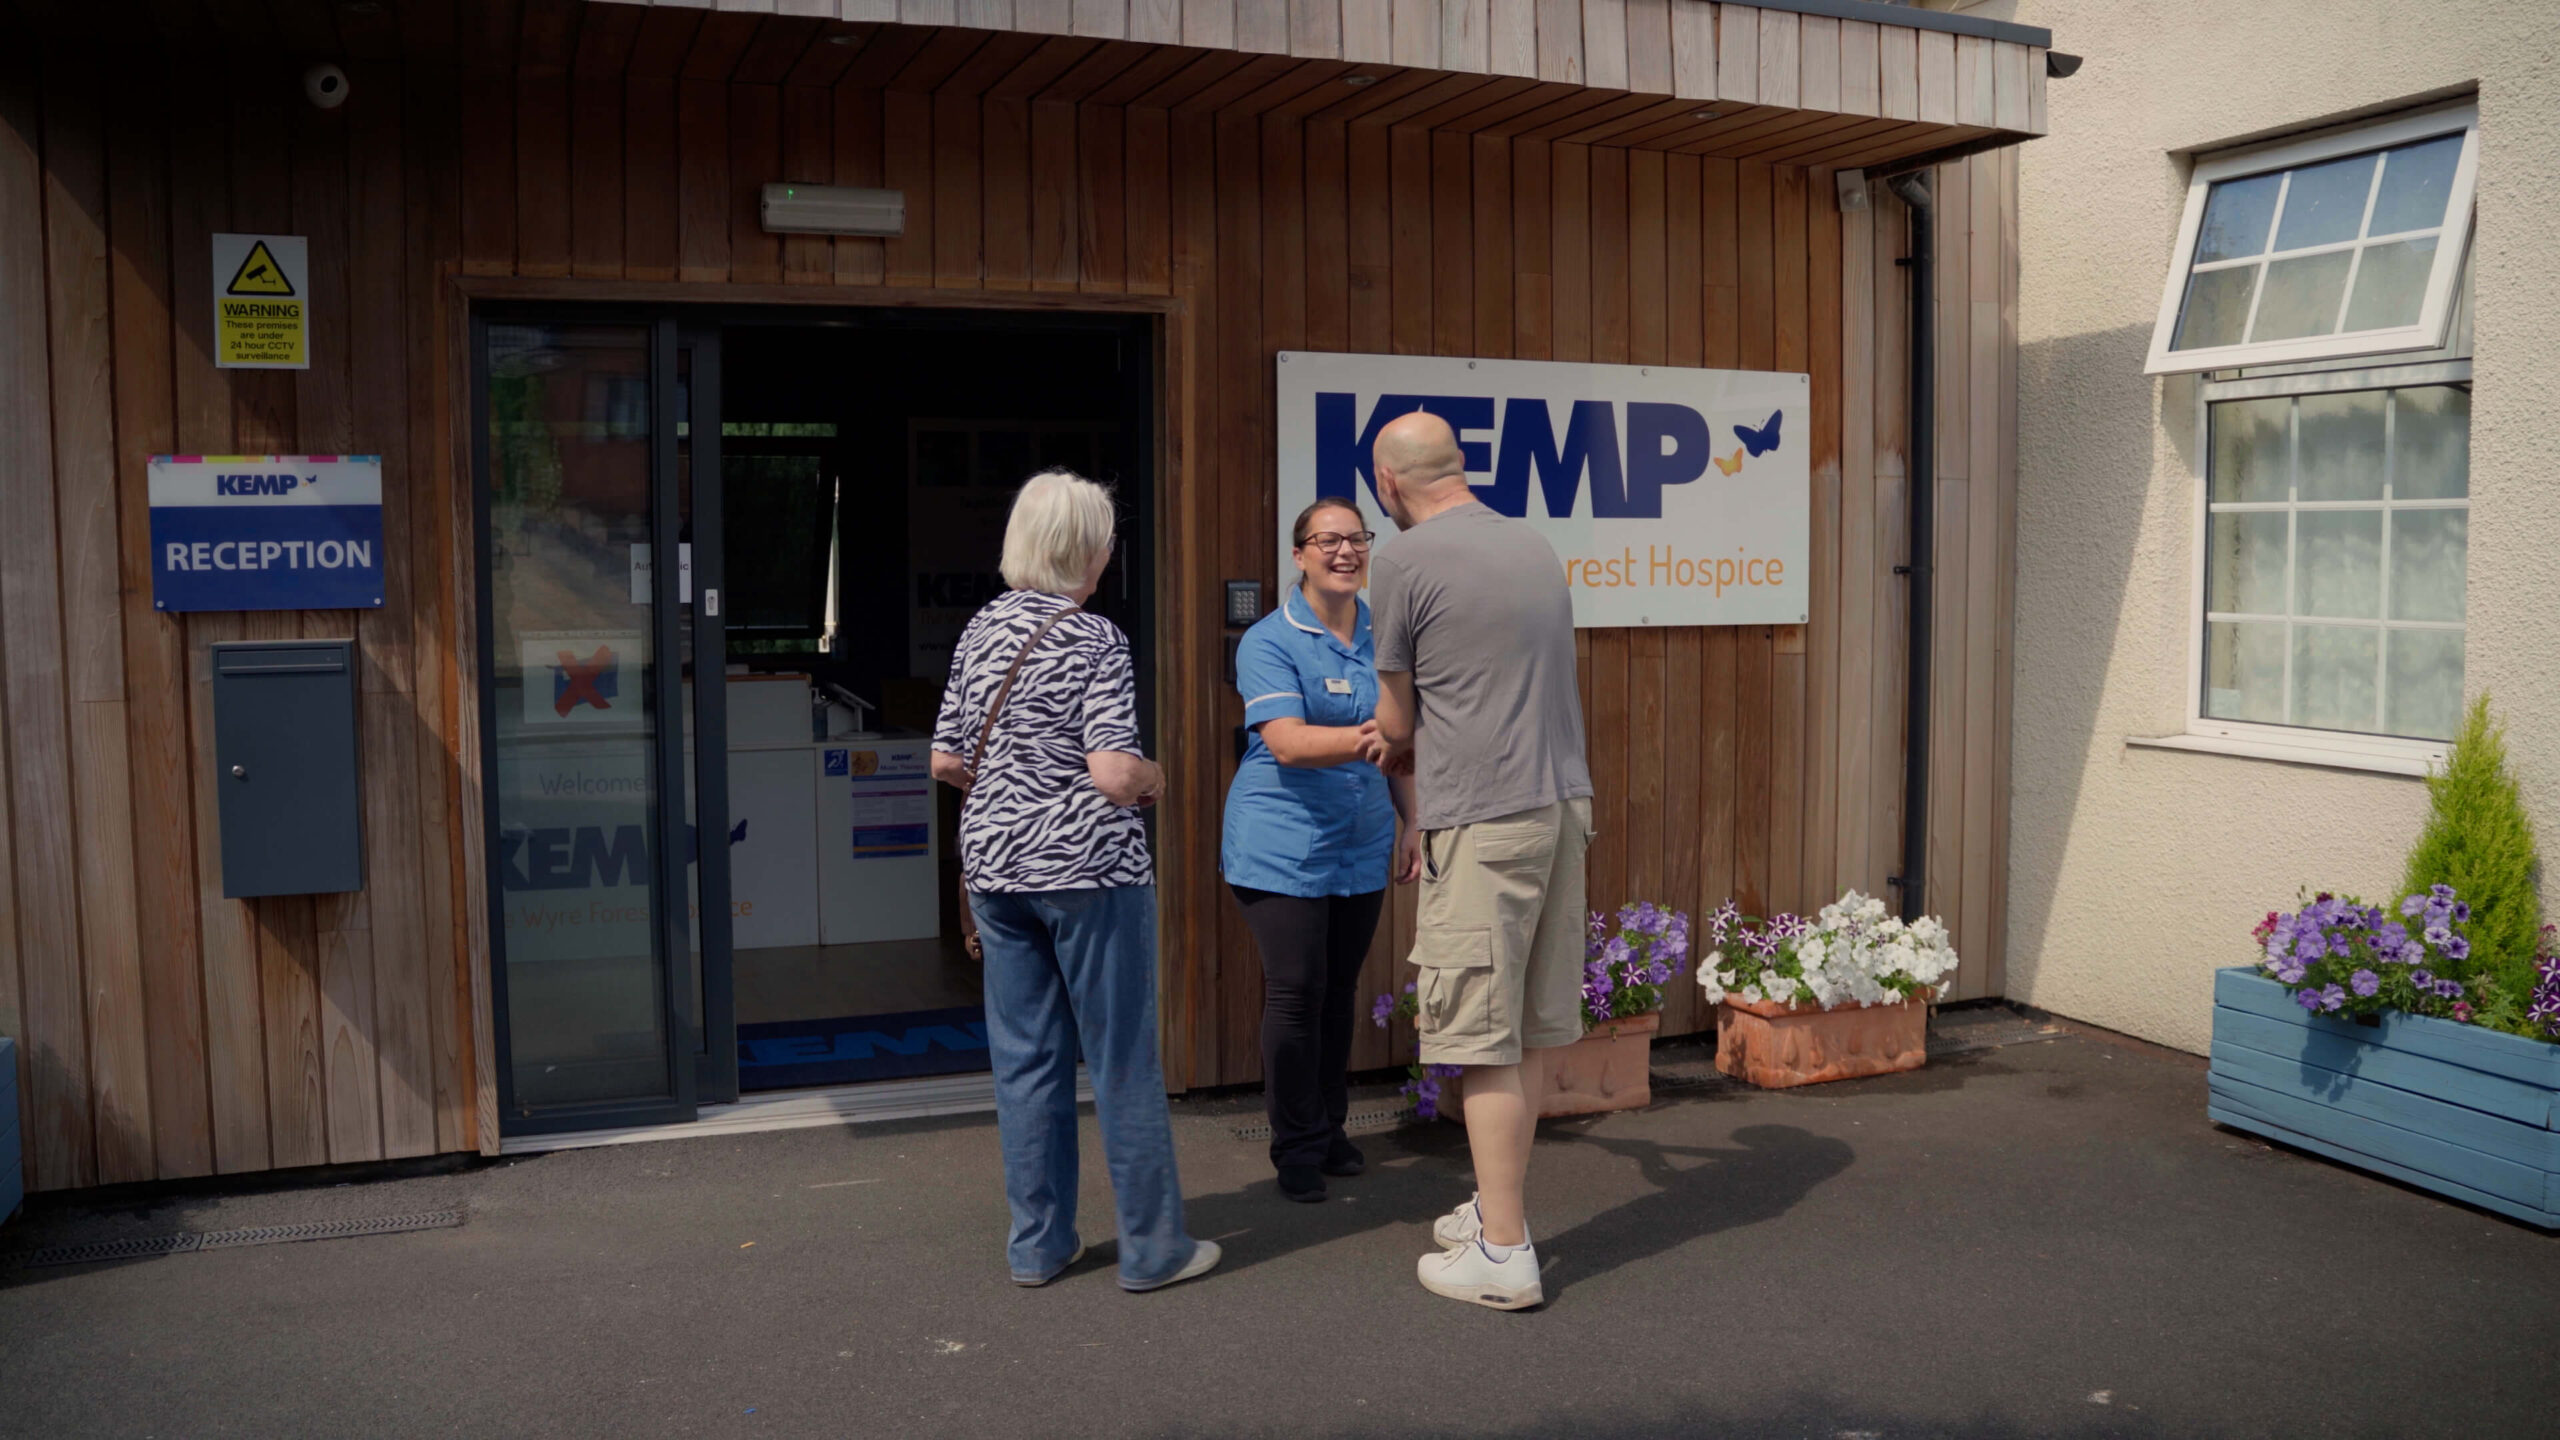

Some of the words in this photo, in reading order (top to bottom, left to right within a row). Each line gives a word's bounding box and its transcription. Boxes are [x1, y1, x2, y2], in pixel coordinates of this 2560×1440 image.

[224, 303, 299, 317] WARNING
[225, 320, 254, 329] These
[256, 321, 298, 331] premises
[240, 332, 256, 340] are
[258, 331, 284, 340] under
[230, 341, 242, 350] 24
[245, 342, 266, 350] hour
[268, 342, 295, 351] CCTV
[235, 352, 290, 361] surveillance
[1315, 392, 1711, 519] KEMP
[217, 474, 298, 496] KEMP
[166, 540, 372, 571] RECEPTION
[1566, 547, 1637, 588] rest
[1649, 544, 1784, 598] Hospice
[539, 771, 648, 796] Welcome
[521, 904, 582, 931] Wyre
[589, 901, 650, 924] Fores
